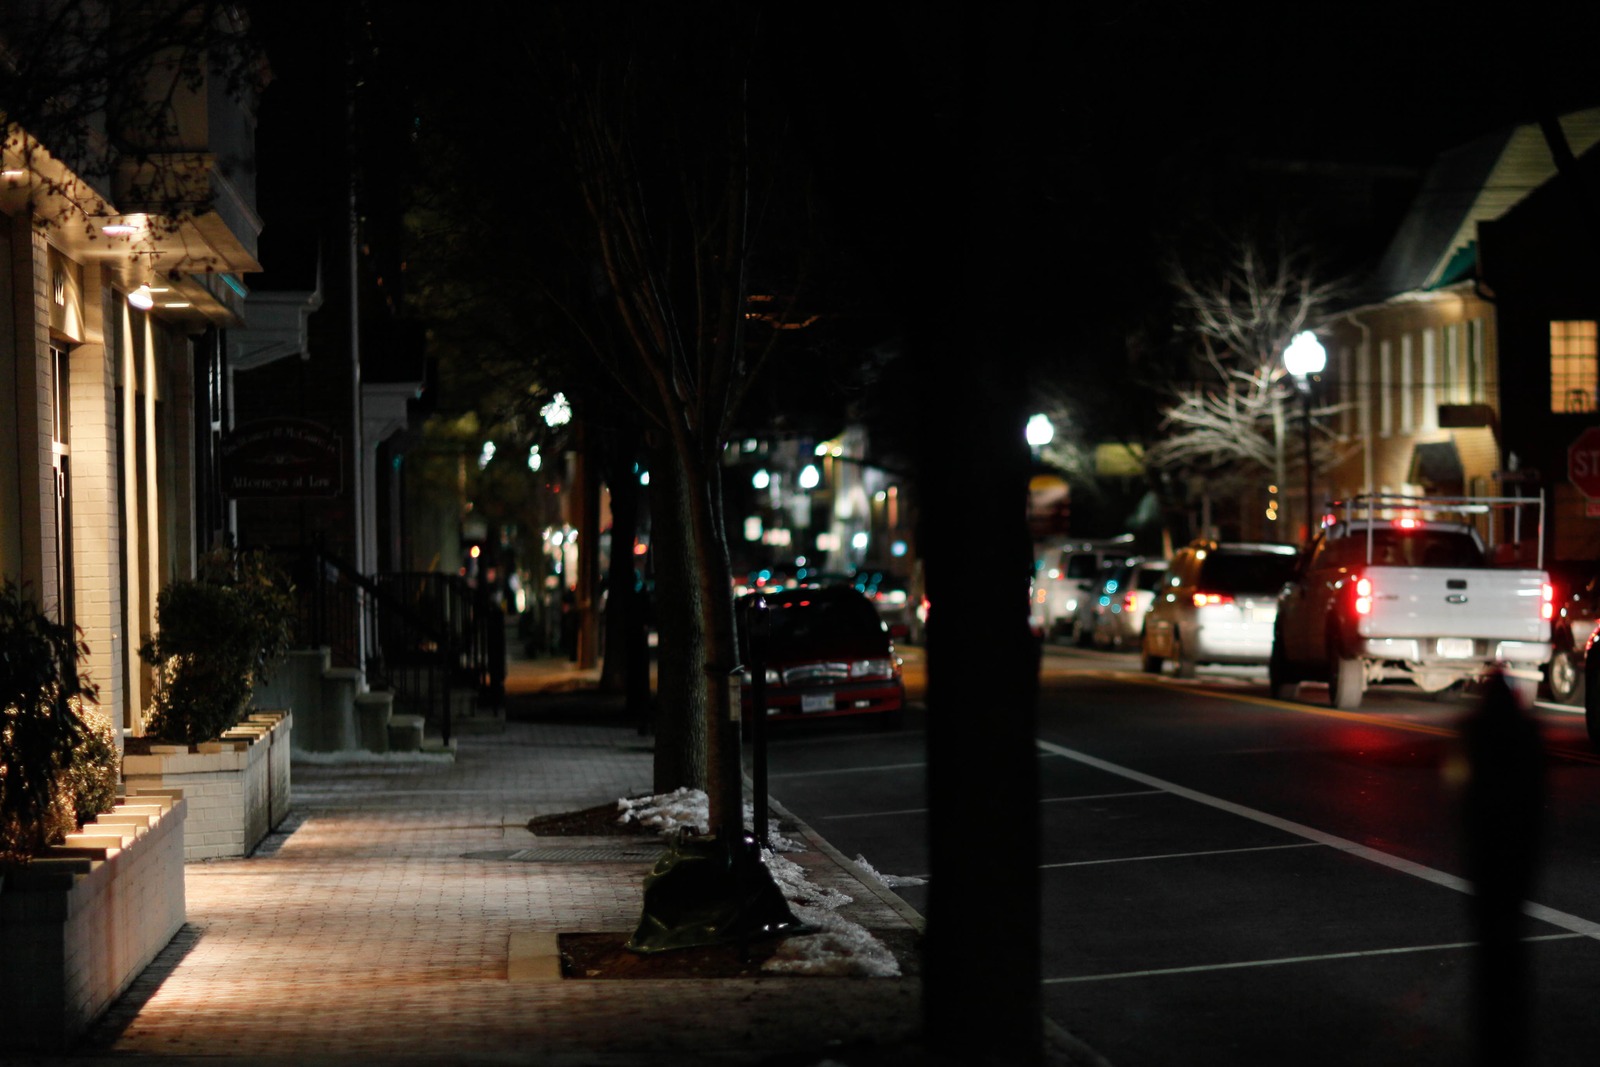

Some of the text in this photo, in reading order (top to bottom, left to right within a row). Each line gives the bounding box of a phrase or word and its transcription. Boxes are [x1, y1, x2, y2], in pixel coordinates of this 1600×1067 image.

[231, 475, 331, 492] Attorneys at Law
